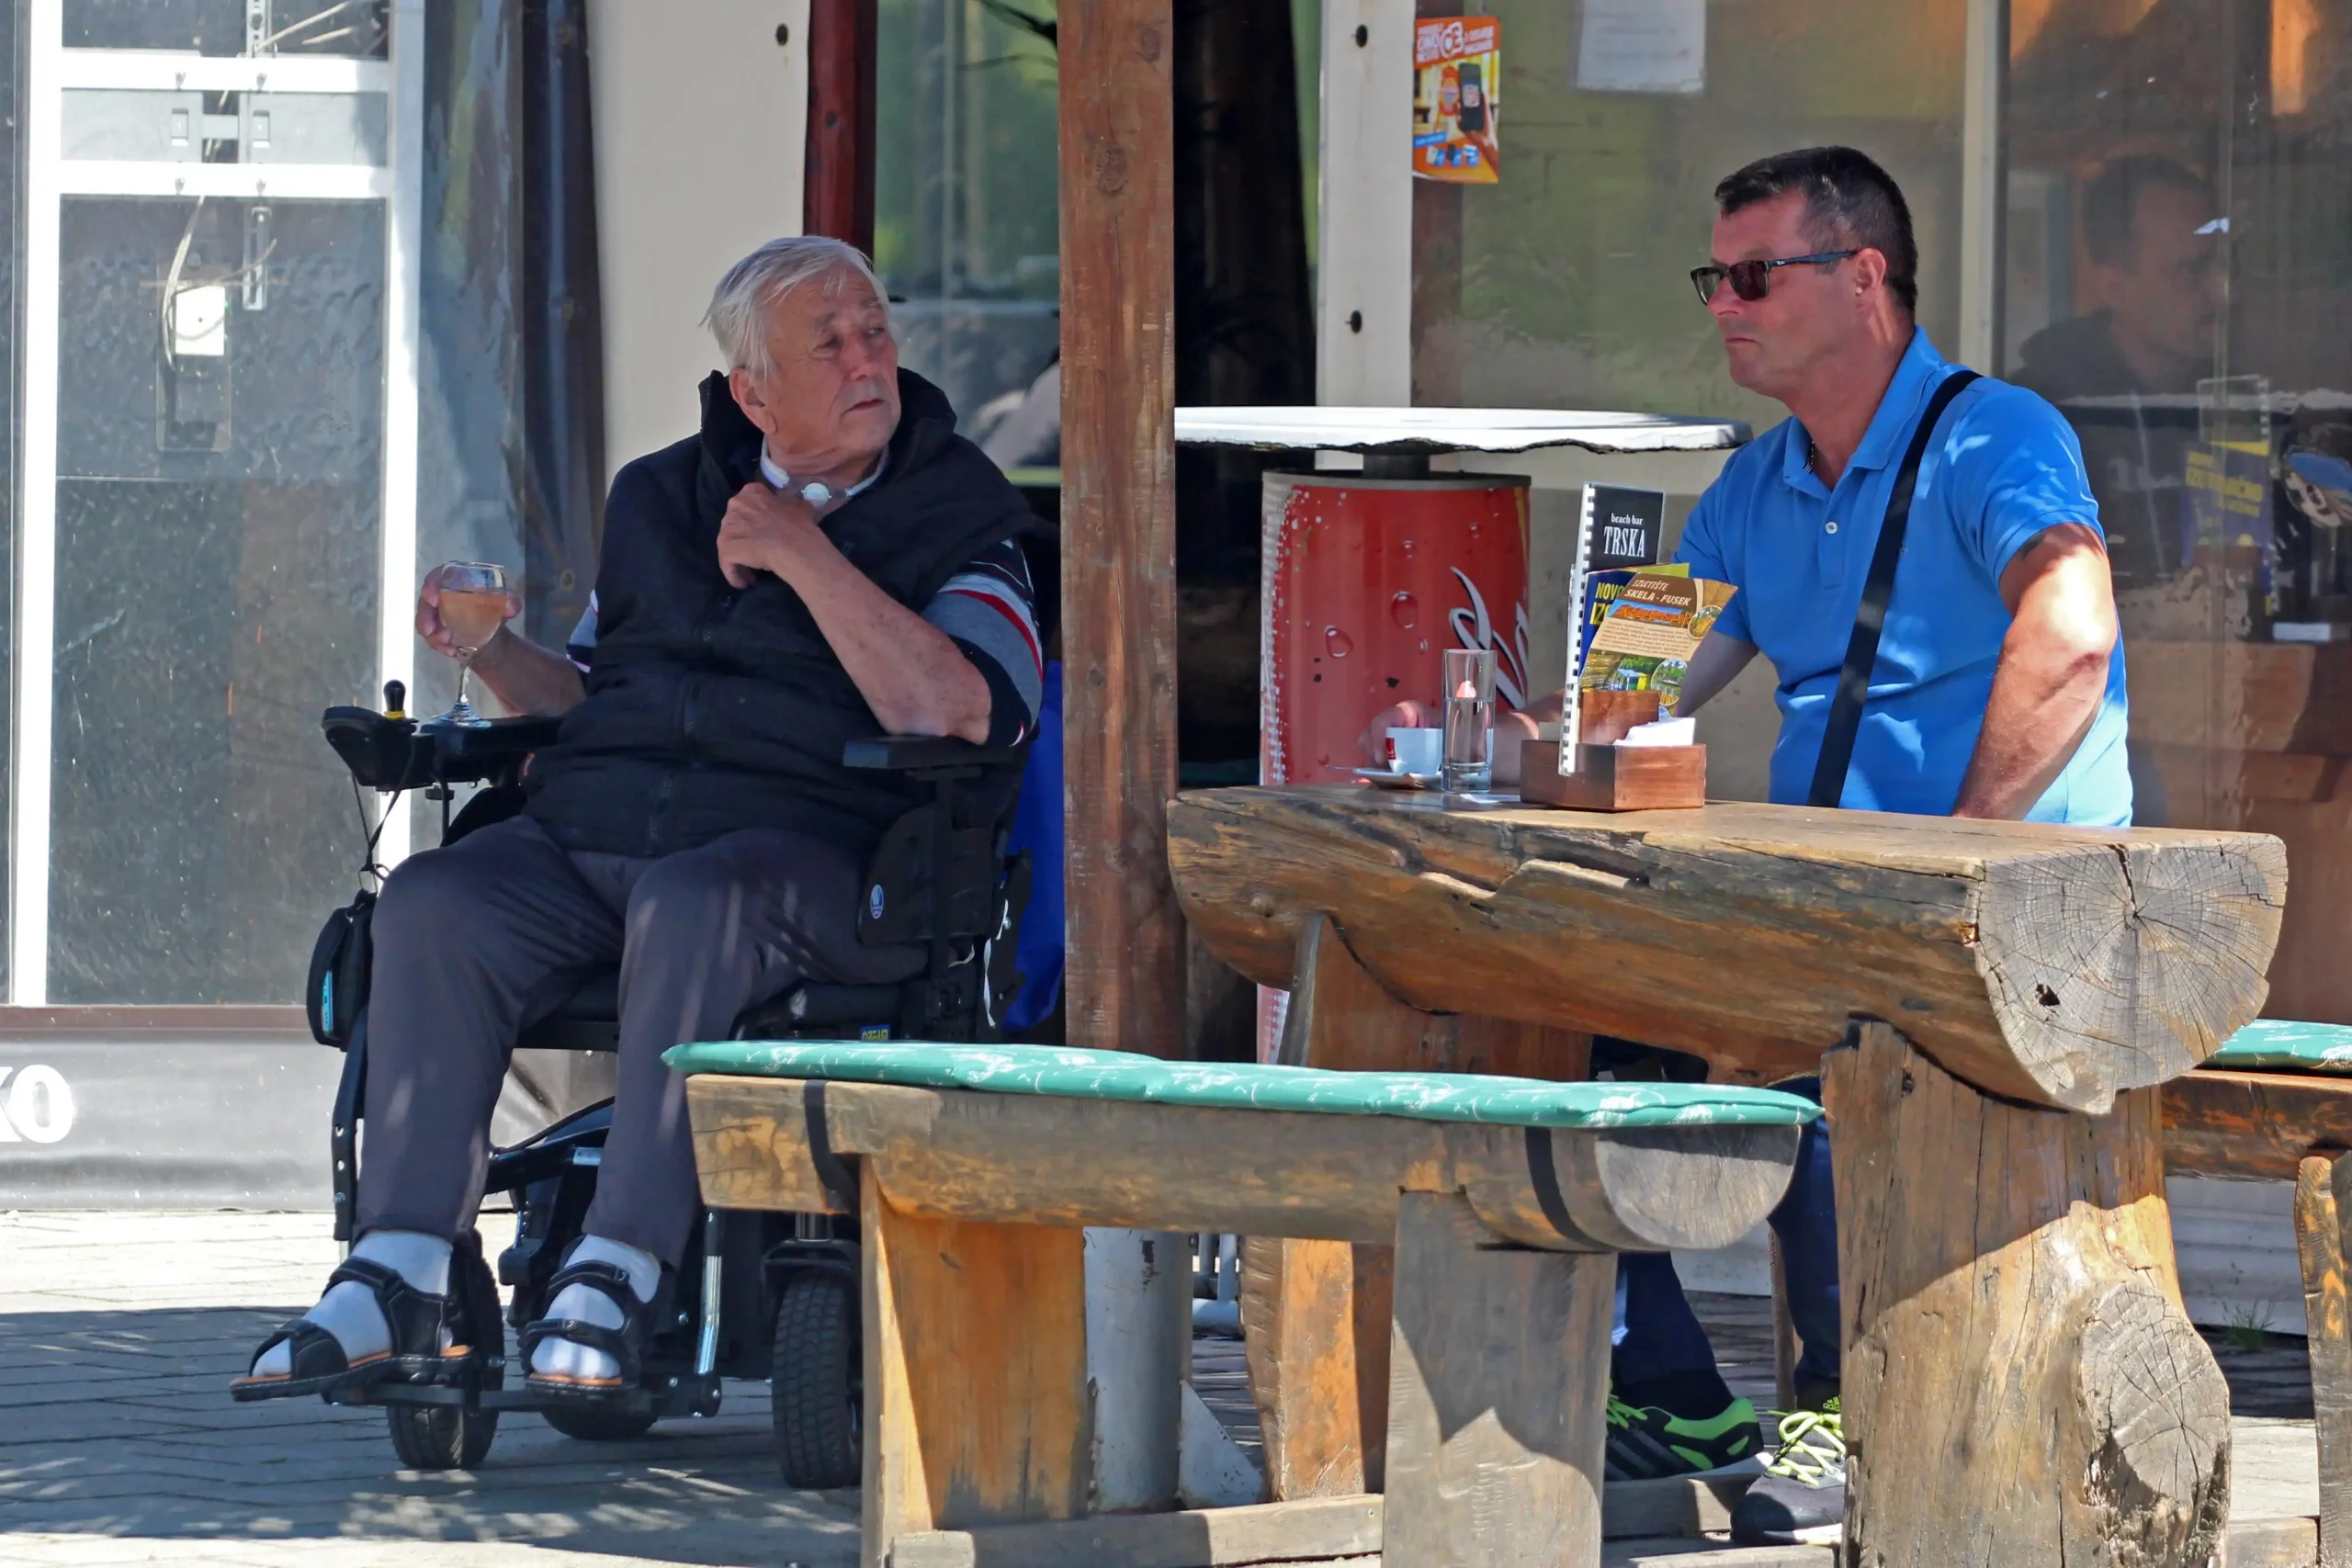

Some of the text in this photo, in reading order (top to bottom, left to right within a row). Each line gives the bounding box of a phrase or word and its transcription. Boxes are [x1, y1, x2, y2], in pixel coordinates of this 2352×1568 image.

[1611, 513, 1644, 525] beach bar
[1603, 525, 1645, 558] TRSKA
[1624, 589, 1656, 602] SKELA
[1659, 594, 1692, 606] FUSEK
